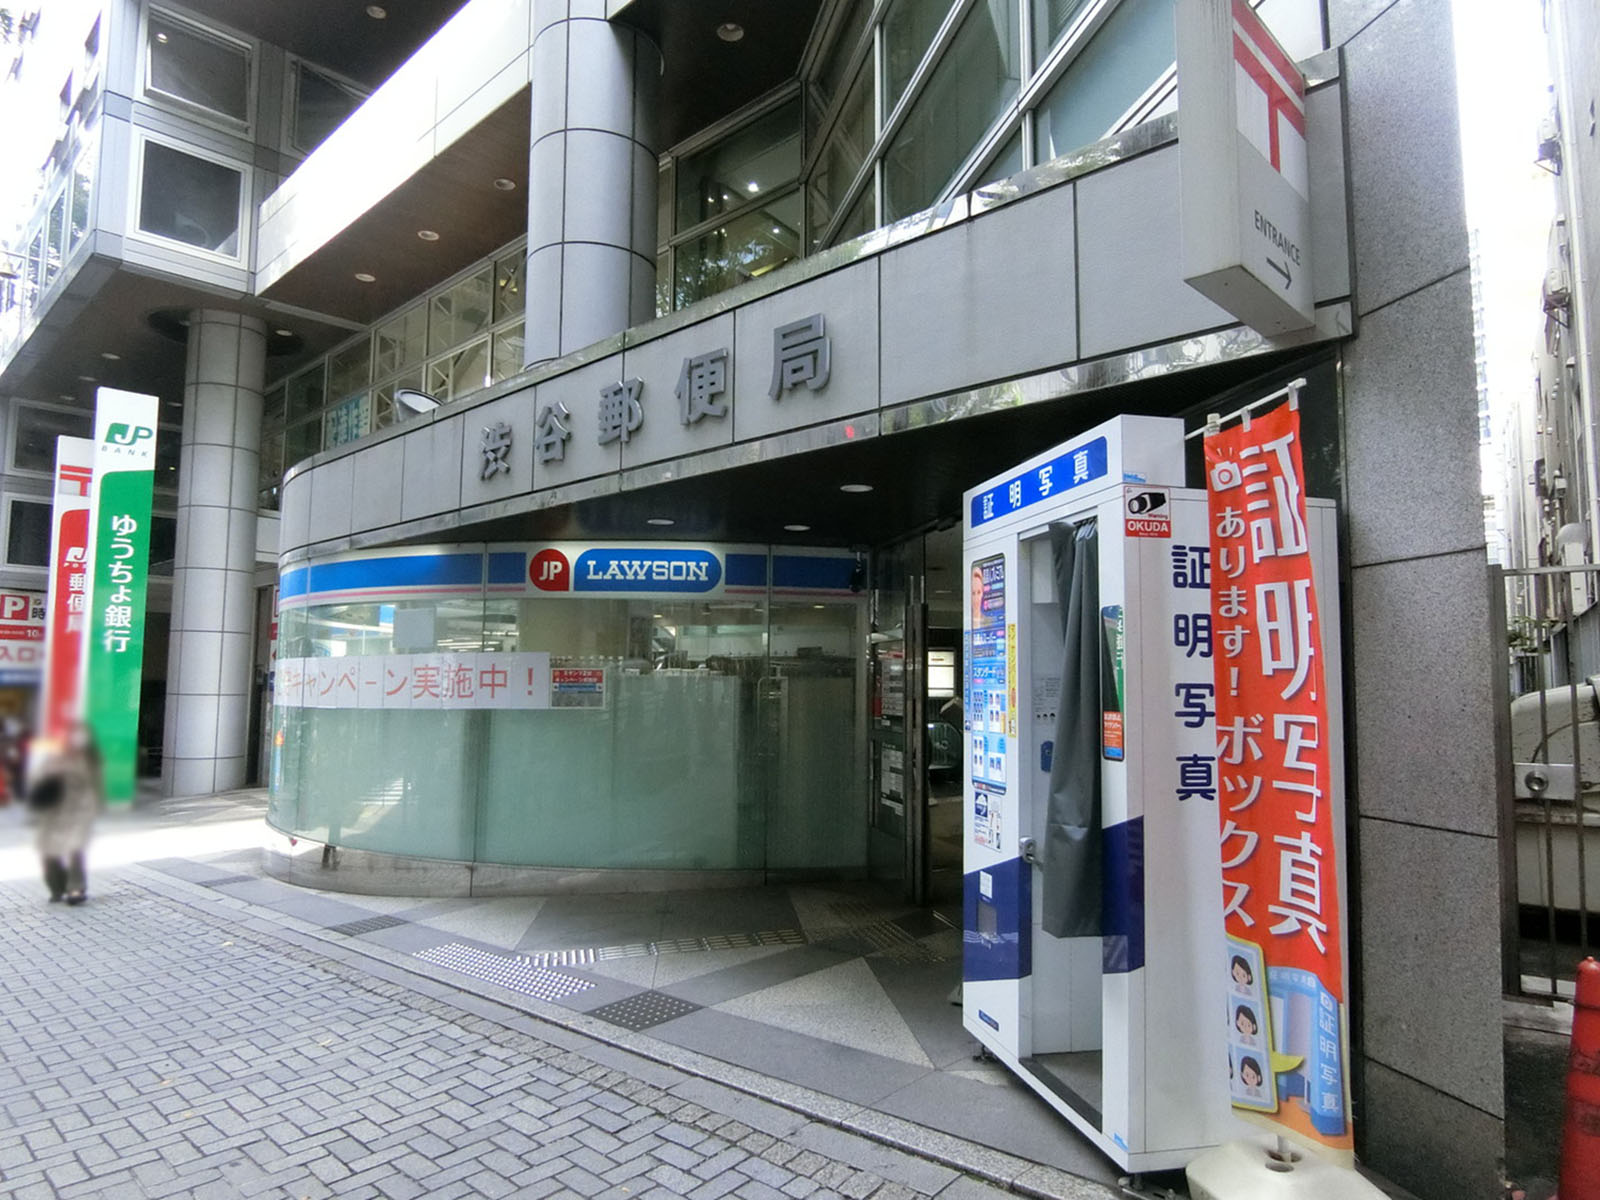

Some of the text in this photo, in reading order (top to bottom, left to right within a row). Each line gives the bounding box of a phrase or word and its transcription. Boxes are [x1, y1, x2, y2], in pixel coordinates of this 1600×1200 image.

[1254, 209, 1301, 267] ENTRANCE
[480, 313, 832, 479] 渋谷郵便局
[101, 446, 148, 458] BANK
[981, 450, 1091, 521] 証明写真
[1127, 521, 1169, 532] OKUDA
[103, 514, 138, 654] ゆうちょ銀行
[538, 560, 563, 580] JP
[586, 560, 709, 582] LAWSON
[1171, 545, 1216, 802] 証明写真
[1217, 713, 1264, 928] ボックス
[1319, 1007, 1338, 1113] 証明写真
